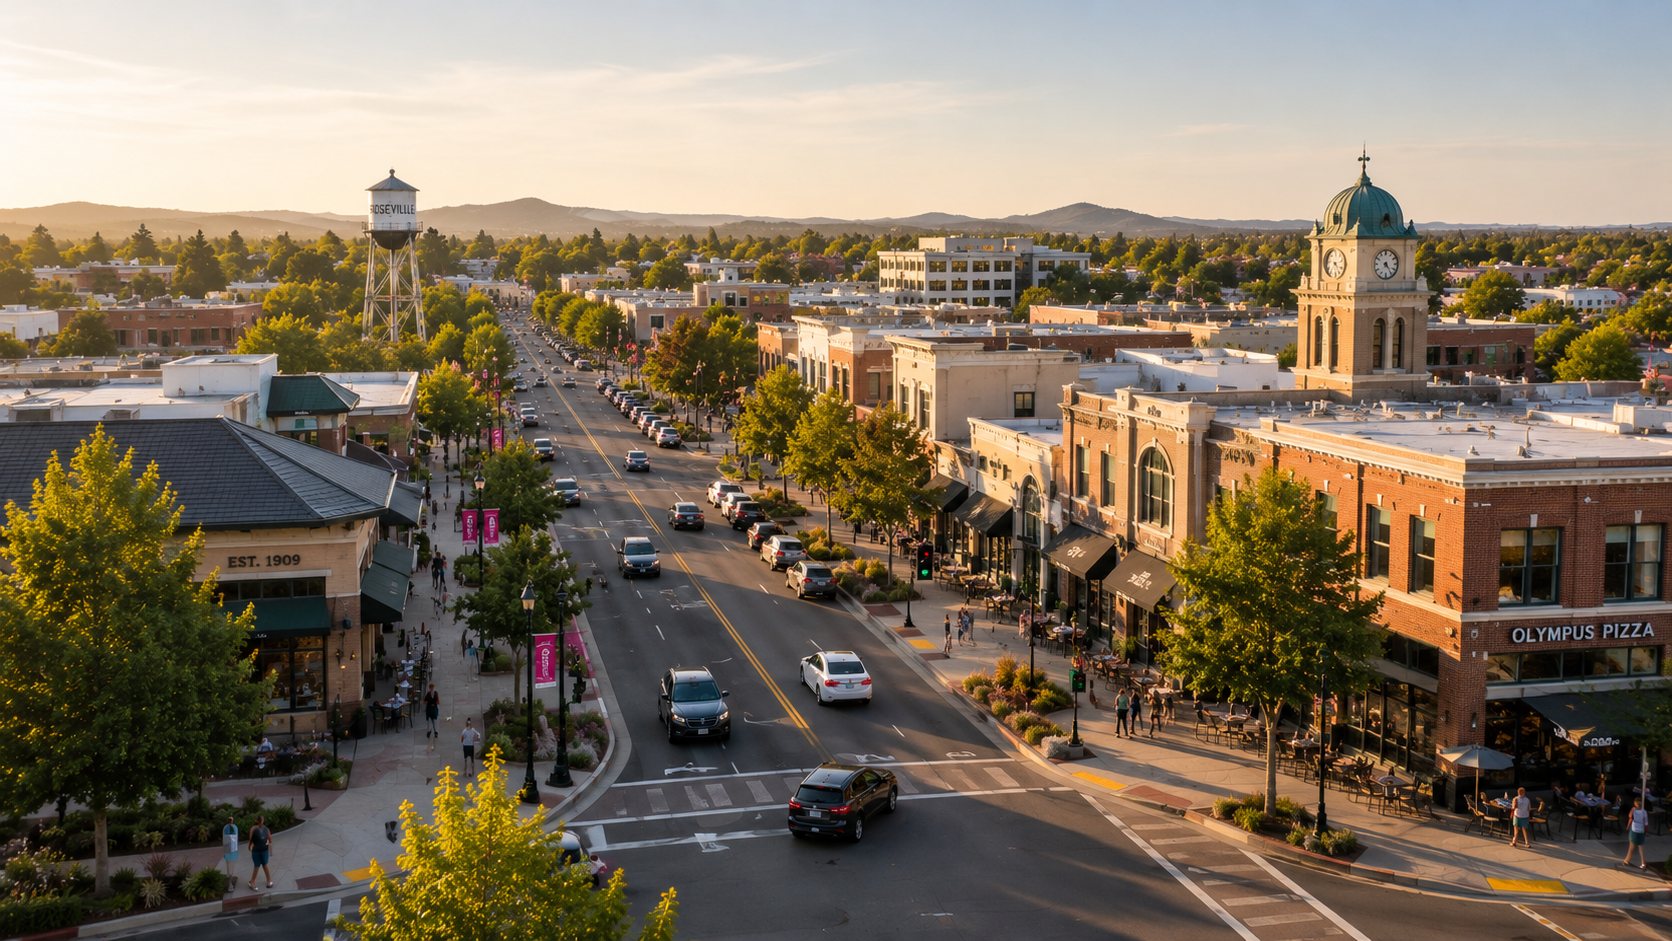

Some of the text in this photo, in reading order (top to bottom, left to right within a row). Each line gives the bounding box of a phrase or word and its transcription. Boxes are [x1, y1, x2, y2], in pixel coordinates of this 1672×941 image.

[227, 554, 301, 568] EST. 1909
[1512, 622, 1655, 643] OLYMPUS PIZZA
